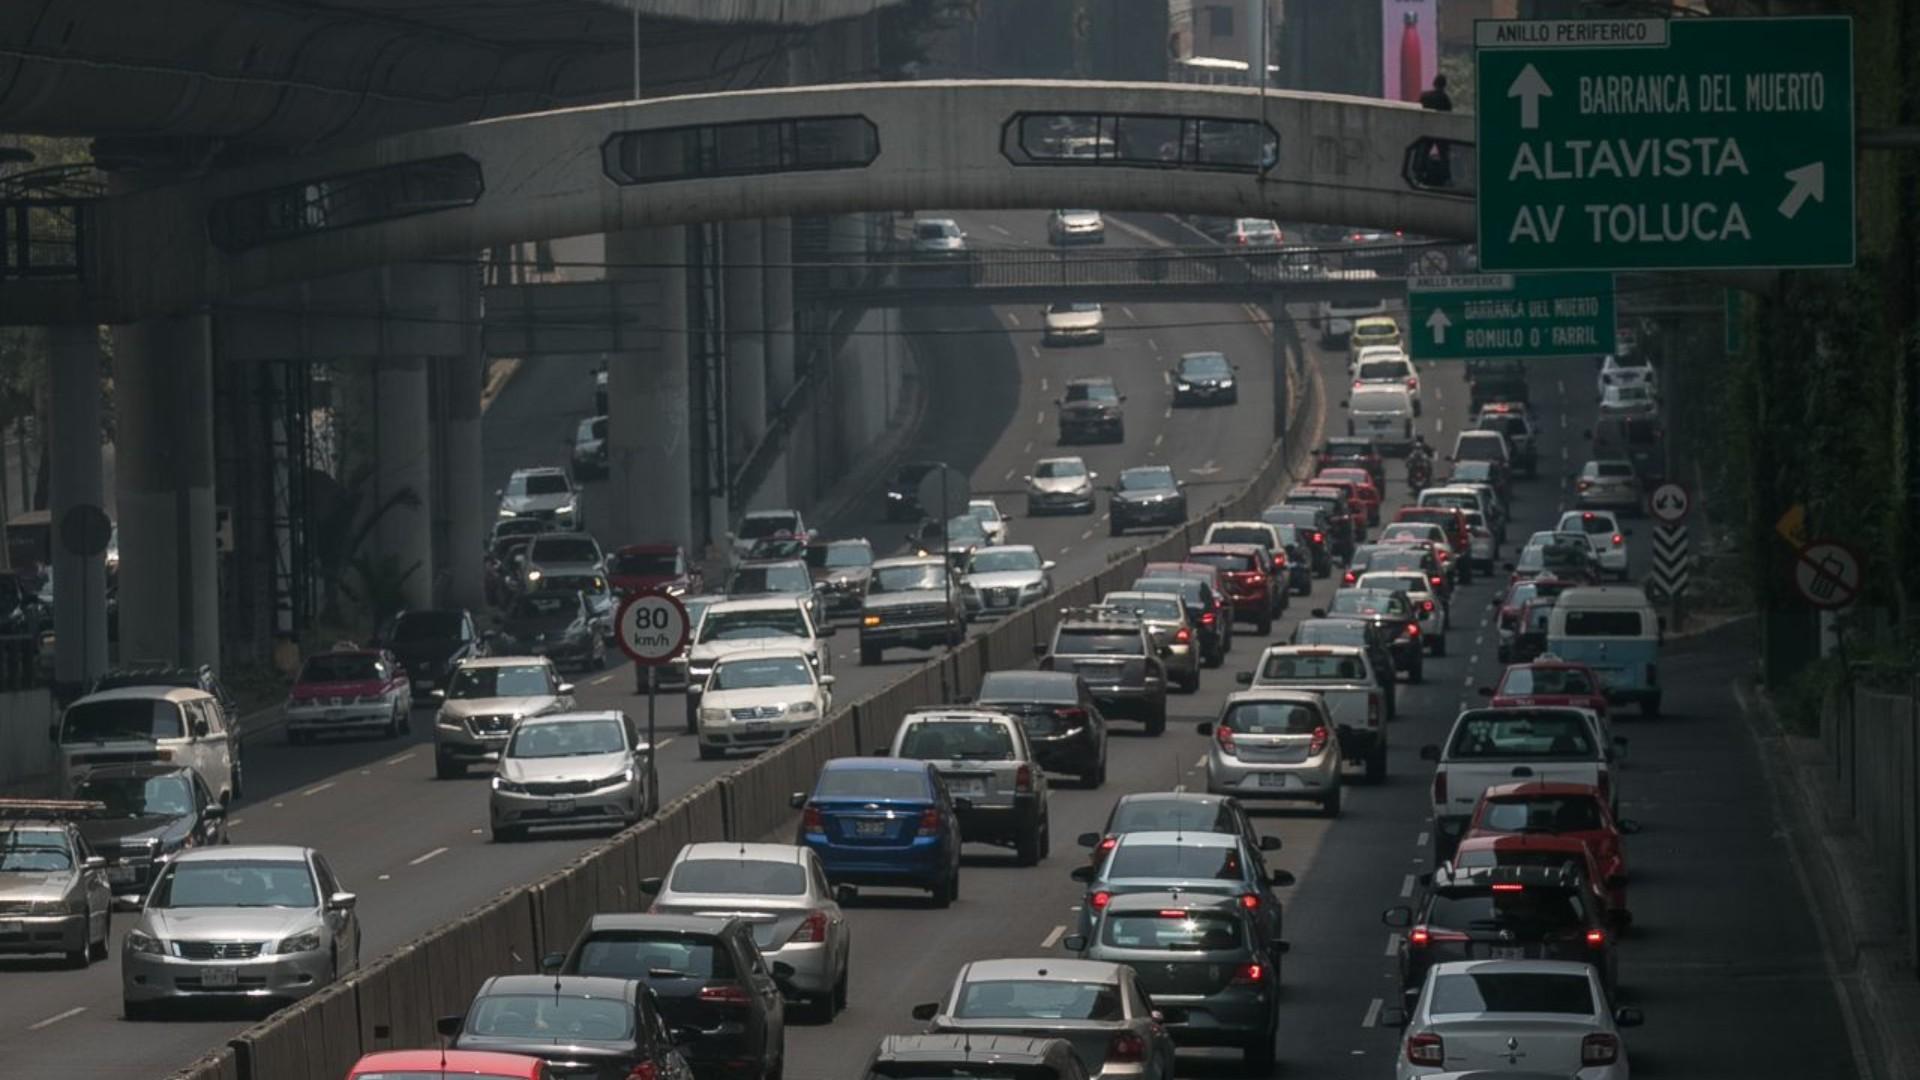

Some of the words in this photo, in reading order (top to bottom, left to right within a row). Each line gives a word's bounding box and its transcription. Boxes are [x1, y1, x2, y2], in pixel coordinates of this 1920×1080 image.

[1496, 25, 1549, 42] ANILLO
[1556, 22, 1647, 41] PERIFERICO
[1579, 75, 1691, 115] BARRANCA
[1699, 74, 1734, 113] DEL
[1746, 72, 1825, 112] MUERTO
[1508, 137, 1750, 181] ALTAVISTA
[1508, 205, 1565, 244] AV
[1585, 201, 1752, 243] TOLUCA
[1464, 301, 1525, 320] BARRANCA
[1529, 299, 1550, 318] DEL
[1554, 297, 1599, 317] MUERTO
[1465, 329, 1523, 348] ROMULO
[636, 607, 669, 629] 80
[634, 632, 670, 647] km/h
